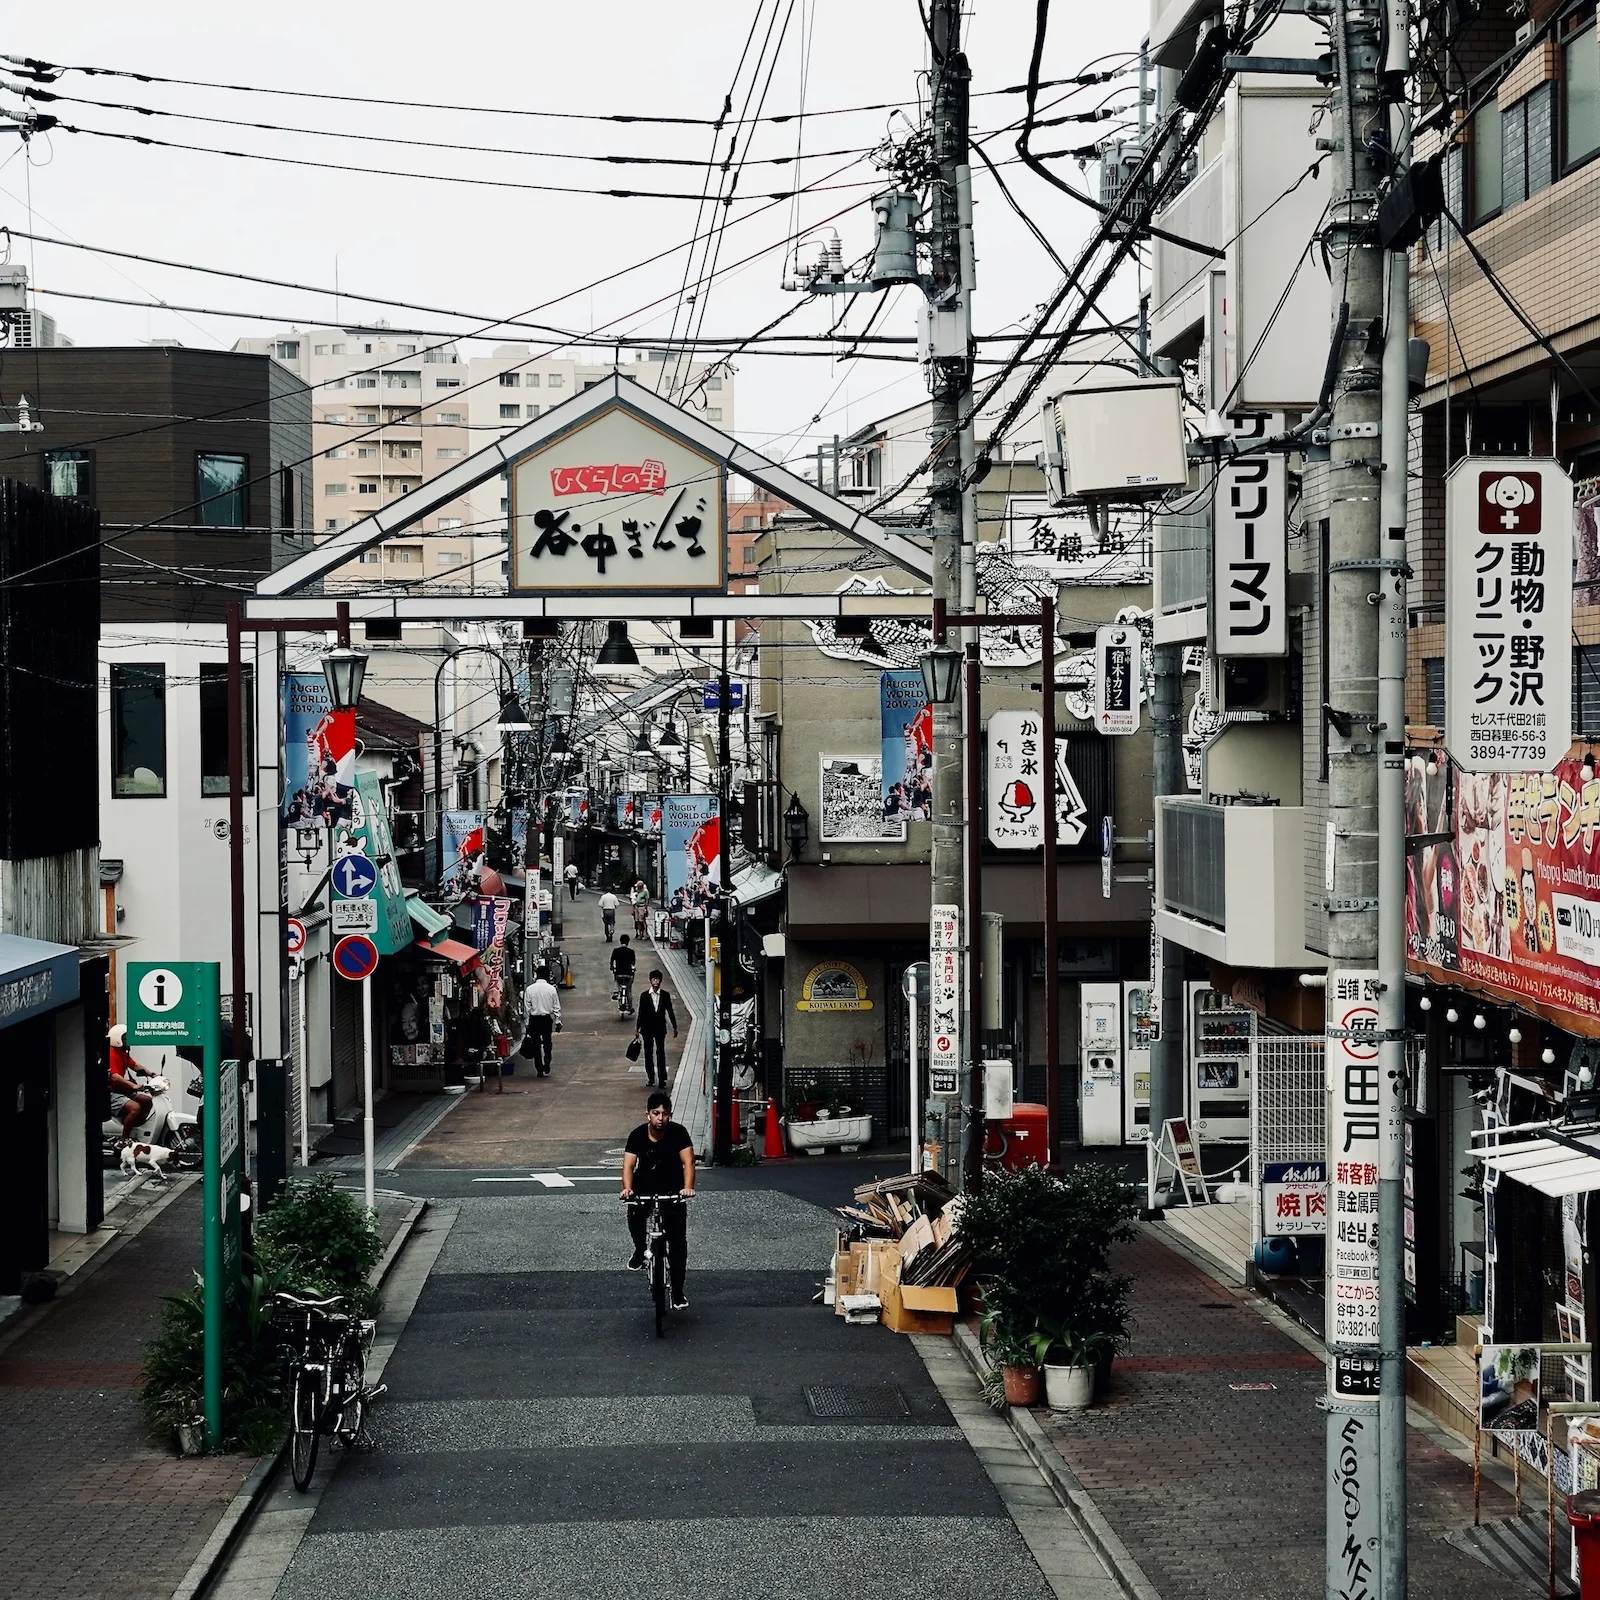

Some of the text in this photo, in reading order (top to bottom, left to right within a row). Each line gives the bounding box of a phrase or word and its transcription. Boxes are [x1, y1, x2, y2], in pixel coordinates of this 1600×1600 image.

[552, 459, 665, 496] ひぐらしの里
[530, 487, 707, 574] 谷中ぎんざ
[1226, 412, 1272, 636] サラリーマン
[1473, 541, 1505, 704] クリニック
[886, 681, 922, 689] RUGBY
[1111, 650, 1124, 707] 宿木カフェ
[291, 685, 326, 693] RUGBY
[886, 690, 924, 698] WORLD
[291, 695, 328, 703] WORLD
[1470, 713, 1546, 726] セレス千代田21前
[1470, 729, 1546, 742] 西日暮里6-56-3
[1020, 720, 1038, 775] かき氷
[1470, 746, 1546, 759] 3894-7739
[336, 914, 373, 922] 一方通行
[1282, 1166, 1320, 1182] Asahi
[1337, 1162, 1379, 1186] 新客歓
[1276, 1192, 1327, 1218] 焼肉
[1337, 1221, 1367, 1243] 새손님
[1337, 1248, 1369, 1261] Facebook
[1337, 1302, 1380, 1318] 谷中3-2
